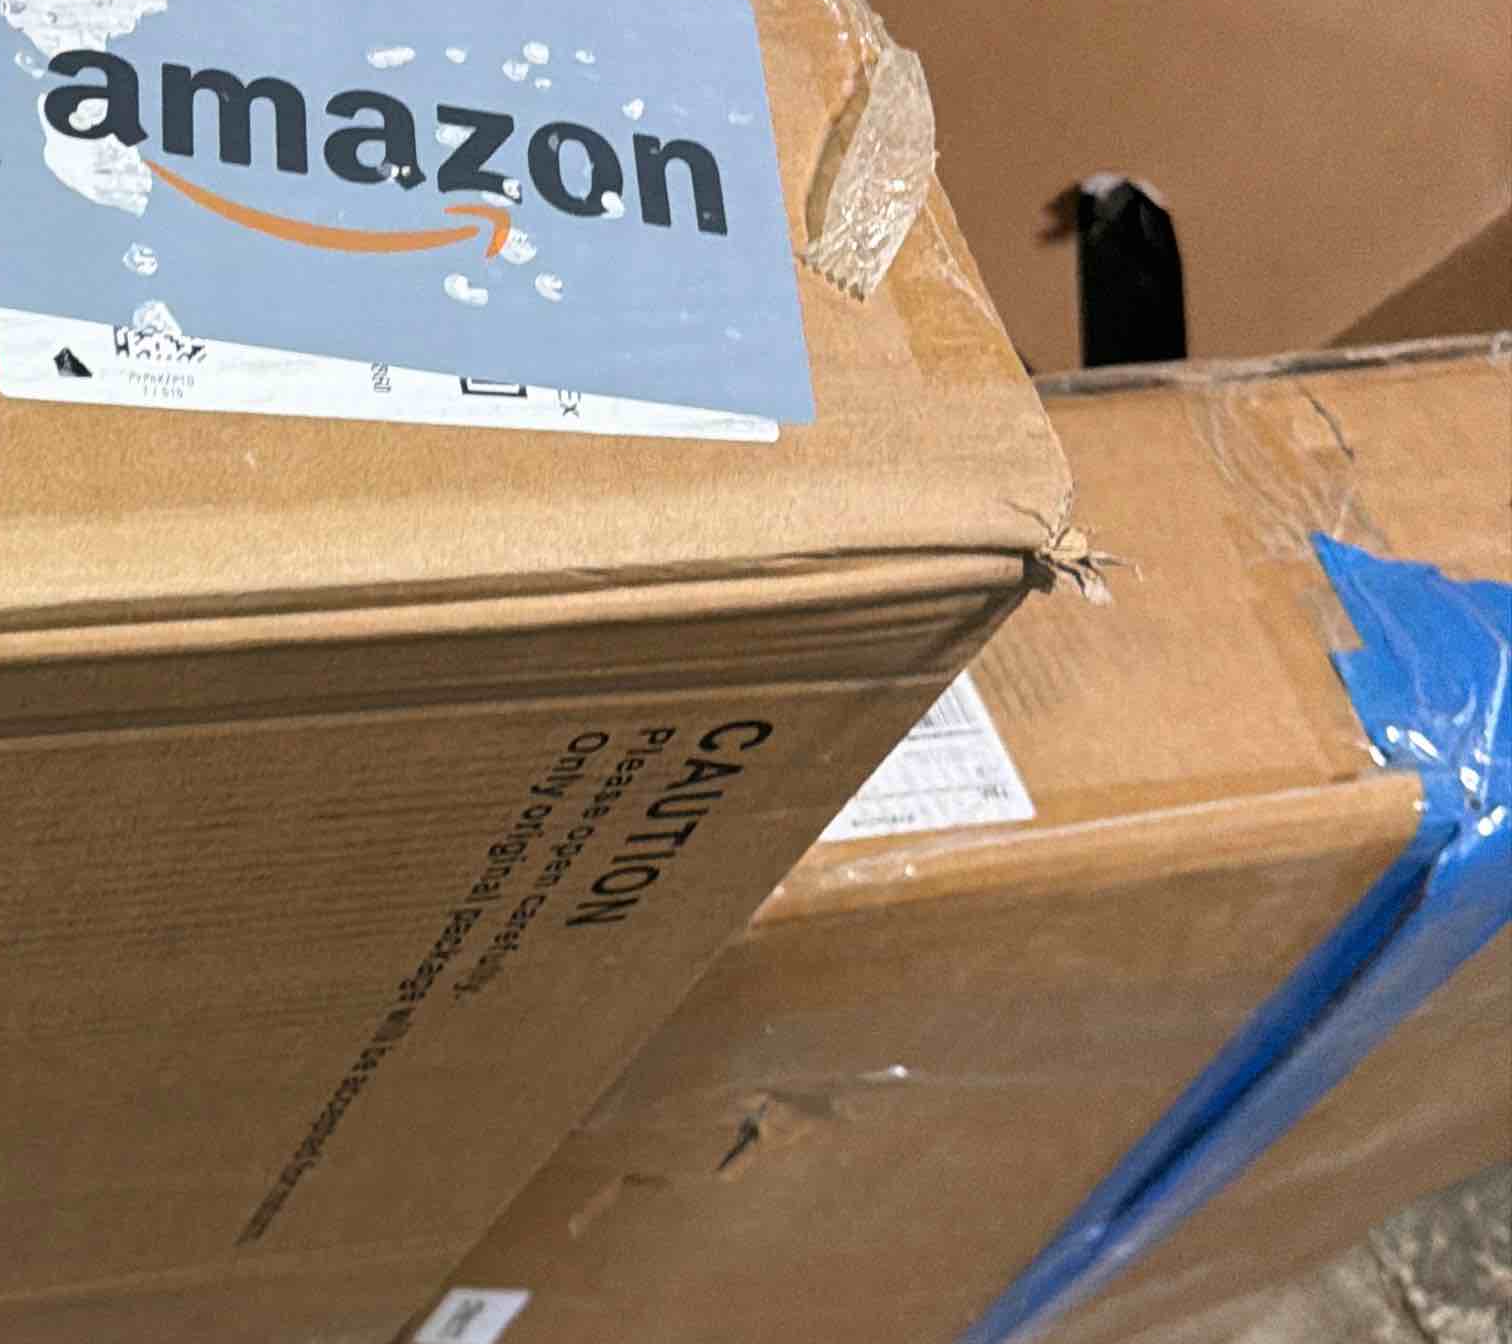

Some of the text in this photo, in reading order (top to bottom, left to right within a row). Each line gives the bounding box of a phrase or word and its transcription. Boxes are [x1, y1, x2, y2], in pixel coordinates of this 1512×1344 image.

[42, 48, 729, 237] amazon
[530, 730, 610, 799] Only
[582, 726, 678, 820] Please
[464, 803, 554, 903] original
[536, 824, 595, 888] open
[565, 719, 774, 929] CAUTION
